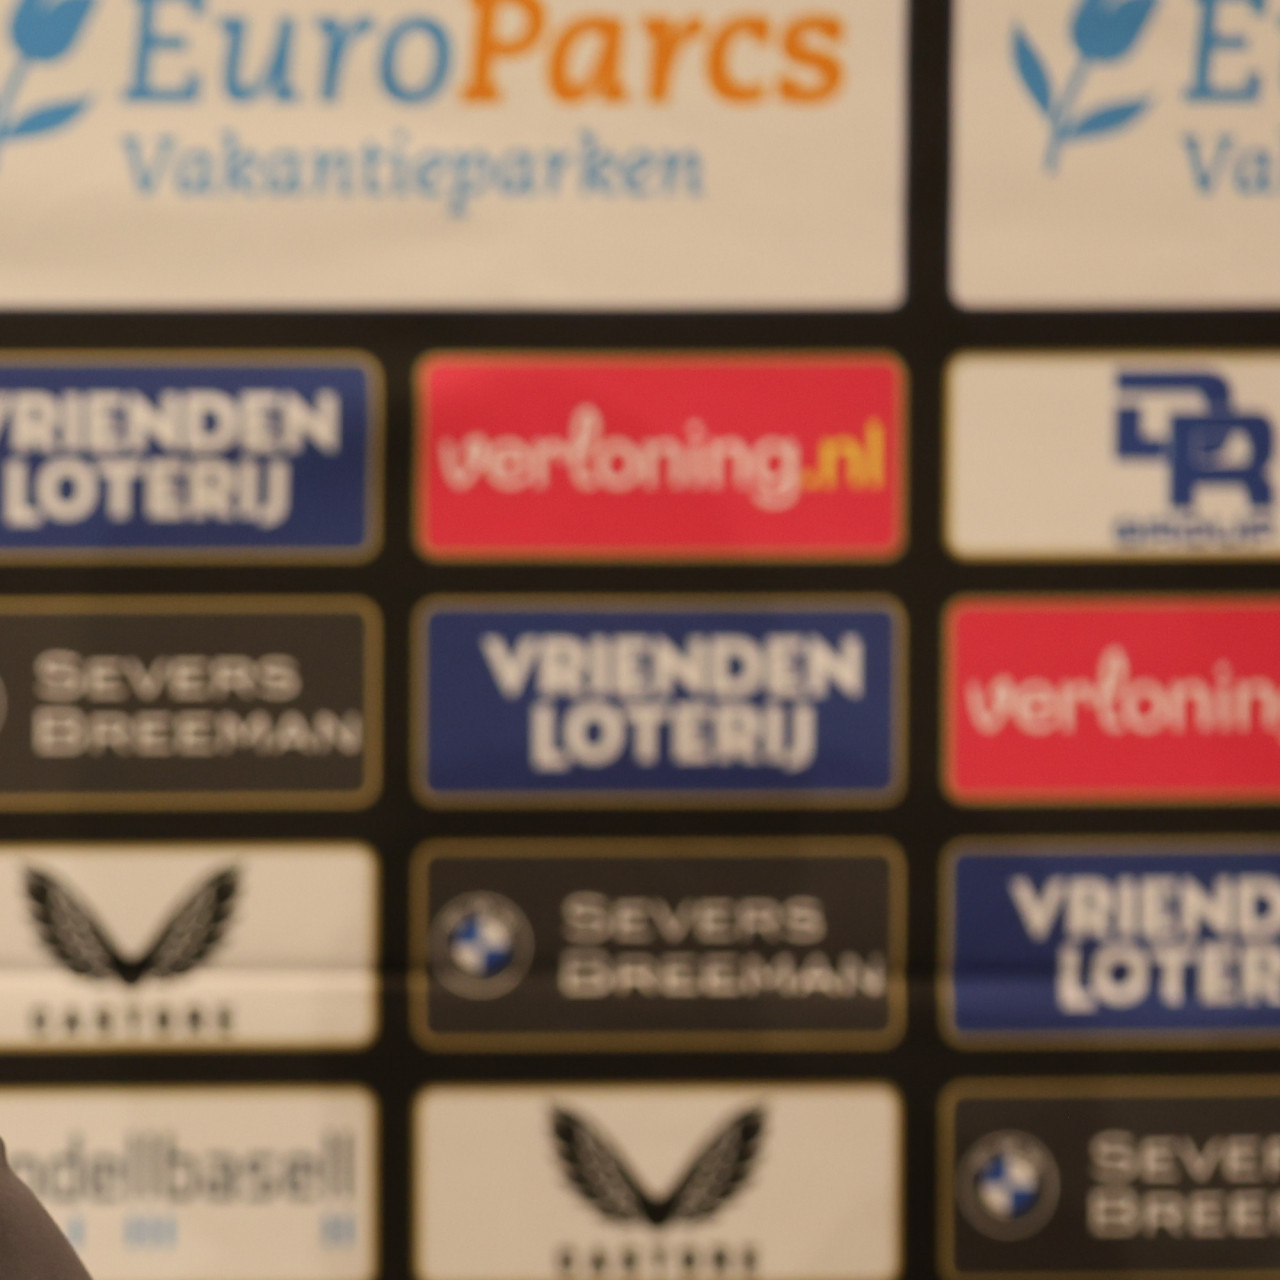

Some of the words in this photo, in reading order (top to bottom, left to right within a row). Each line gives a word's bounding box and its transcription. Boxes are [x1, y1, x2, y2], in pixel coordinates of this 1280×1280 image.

[121, 0, 845, 105] EuroParcs
[121, 132, 706, 220] Vakantieparken
[438, 402, 887, 513] verloning.nl
[1, 457, 293, 530] LOTERIJ
[32, 651, 302, 704] SEVERS
[480, 631, 865, 700] VRIENDEN
[965, 645, 1280, 738] verlonin
[31, 708, 365, 759] BREEMAN
[529, 700, 818, 774] LOTERIJ
[558, 891, 828, 946] SEVERS
[557, 948, 889, 1001] BREEMAN
[1087, 1129, 1280, 1186] SEVE
[1086, 1187, 1280, 1241] BREE
